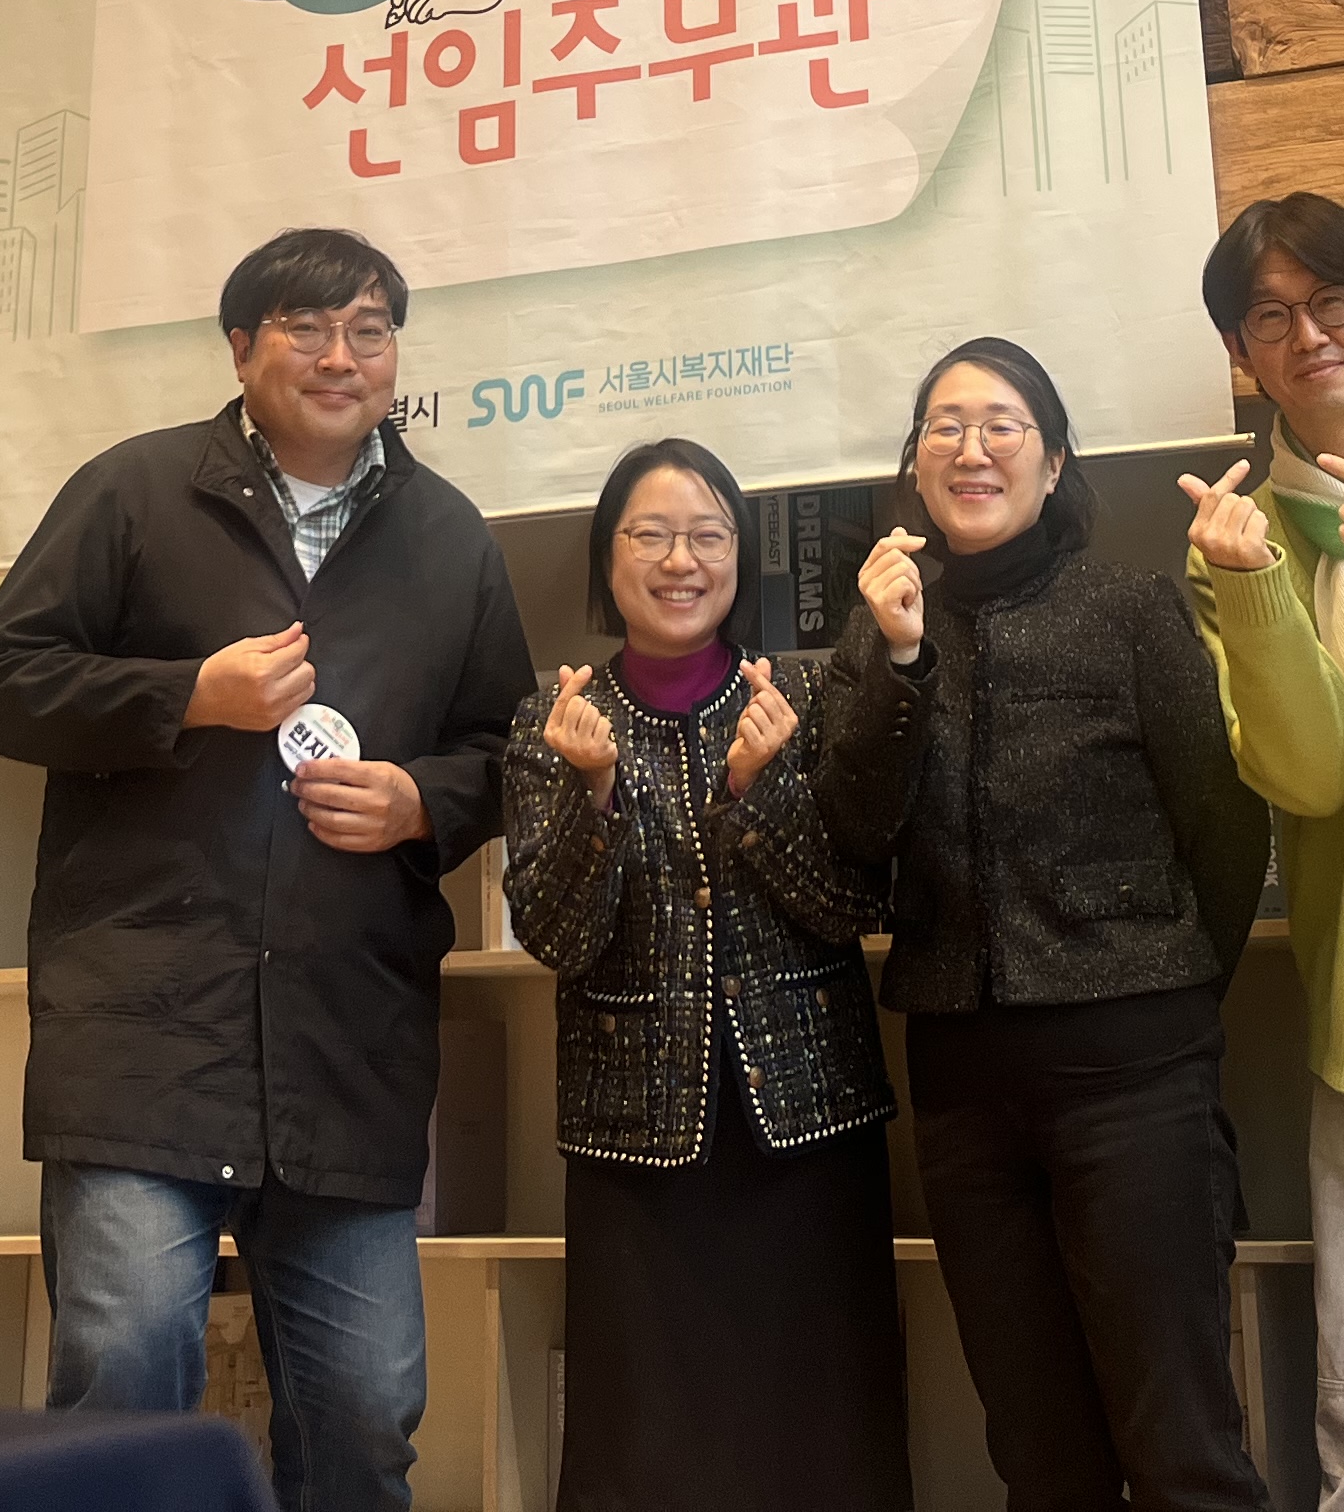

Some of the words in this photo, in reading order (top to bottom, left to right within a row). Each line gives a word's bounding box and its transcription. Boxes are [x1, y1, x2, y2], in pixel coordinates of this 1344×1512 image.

[599, 342, 794, 395] 서울시복지재단
[599, 397, 640, 414] SEOUL
[643, 391, 703, 409] WELFARE
[706, 379, 793, 402] FOUNDATION
[767, 495, 782, 568] YPEBEAST
[796, 494, 825, 632] DREAMS
